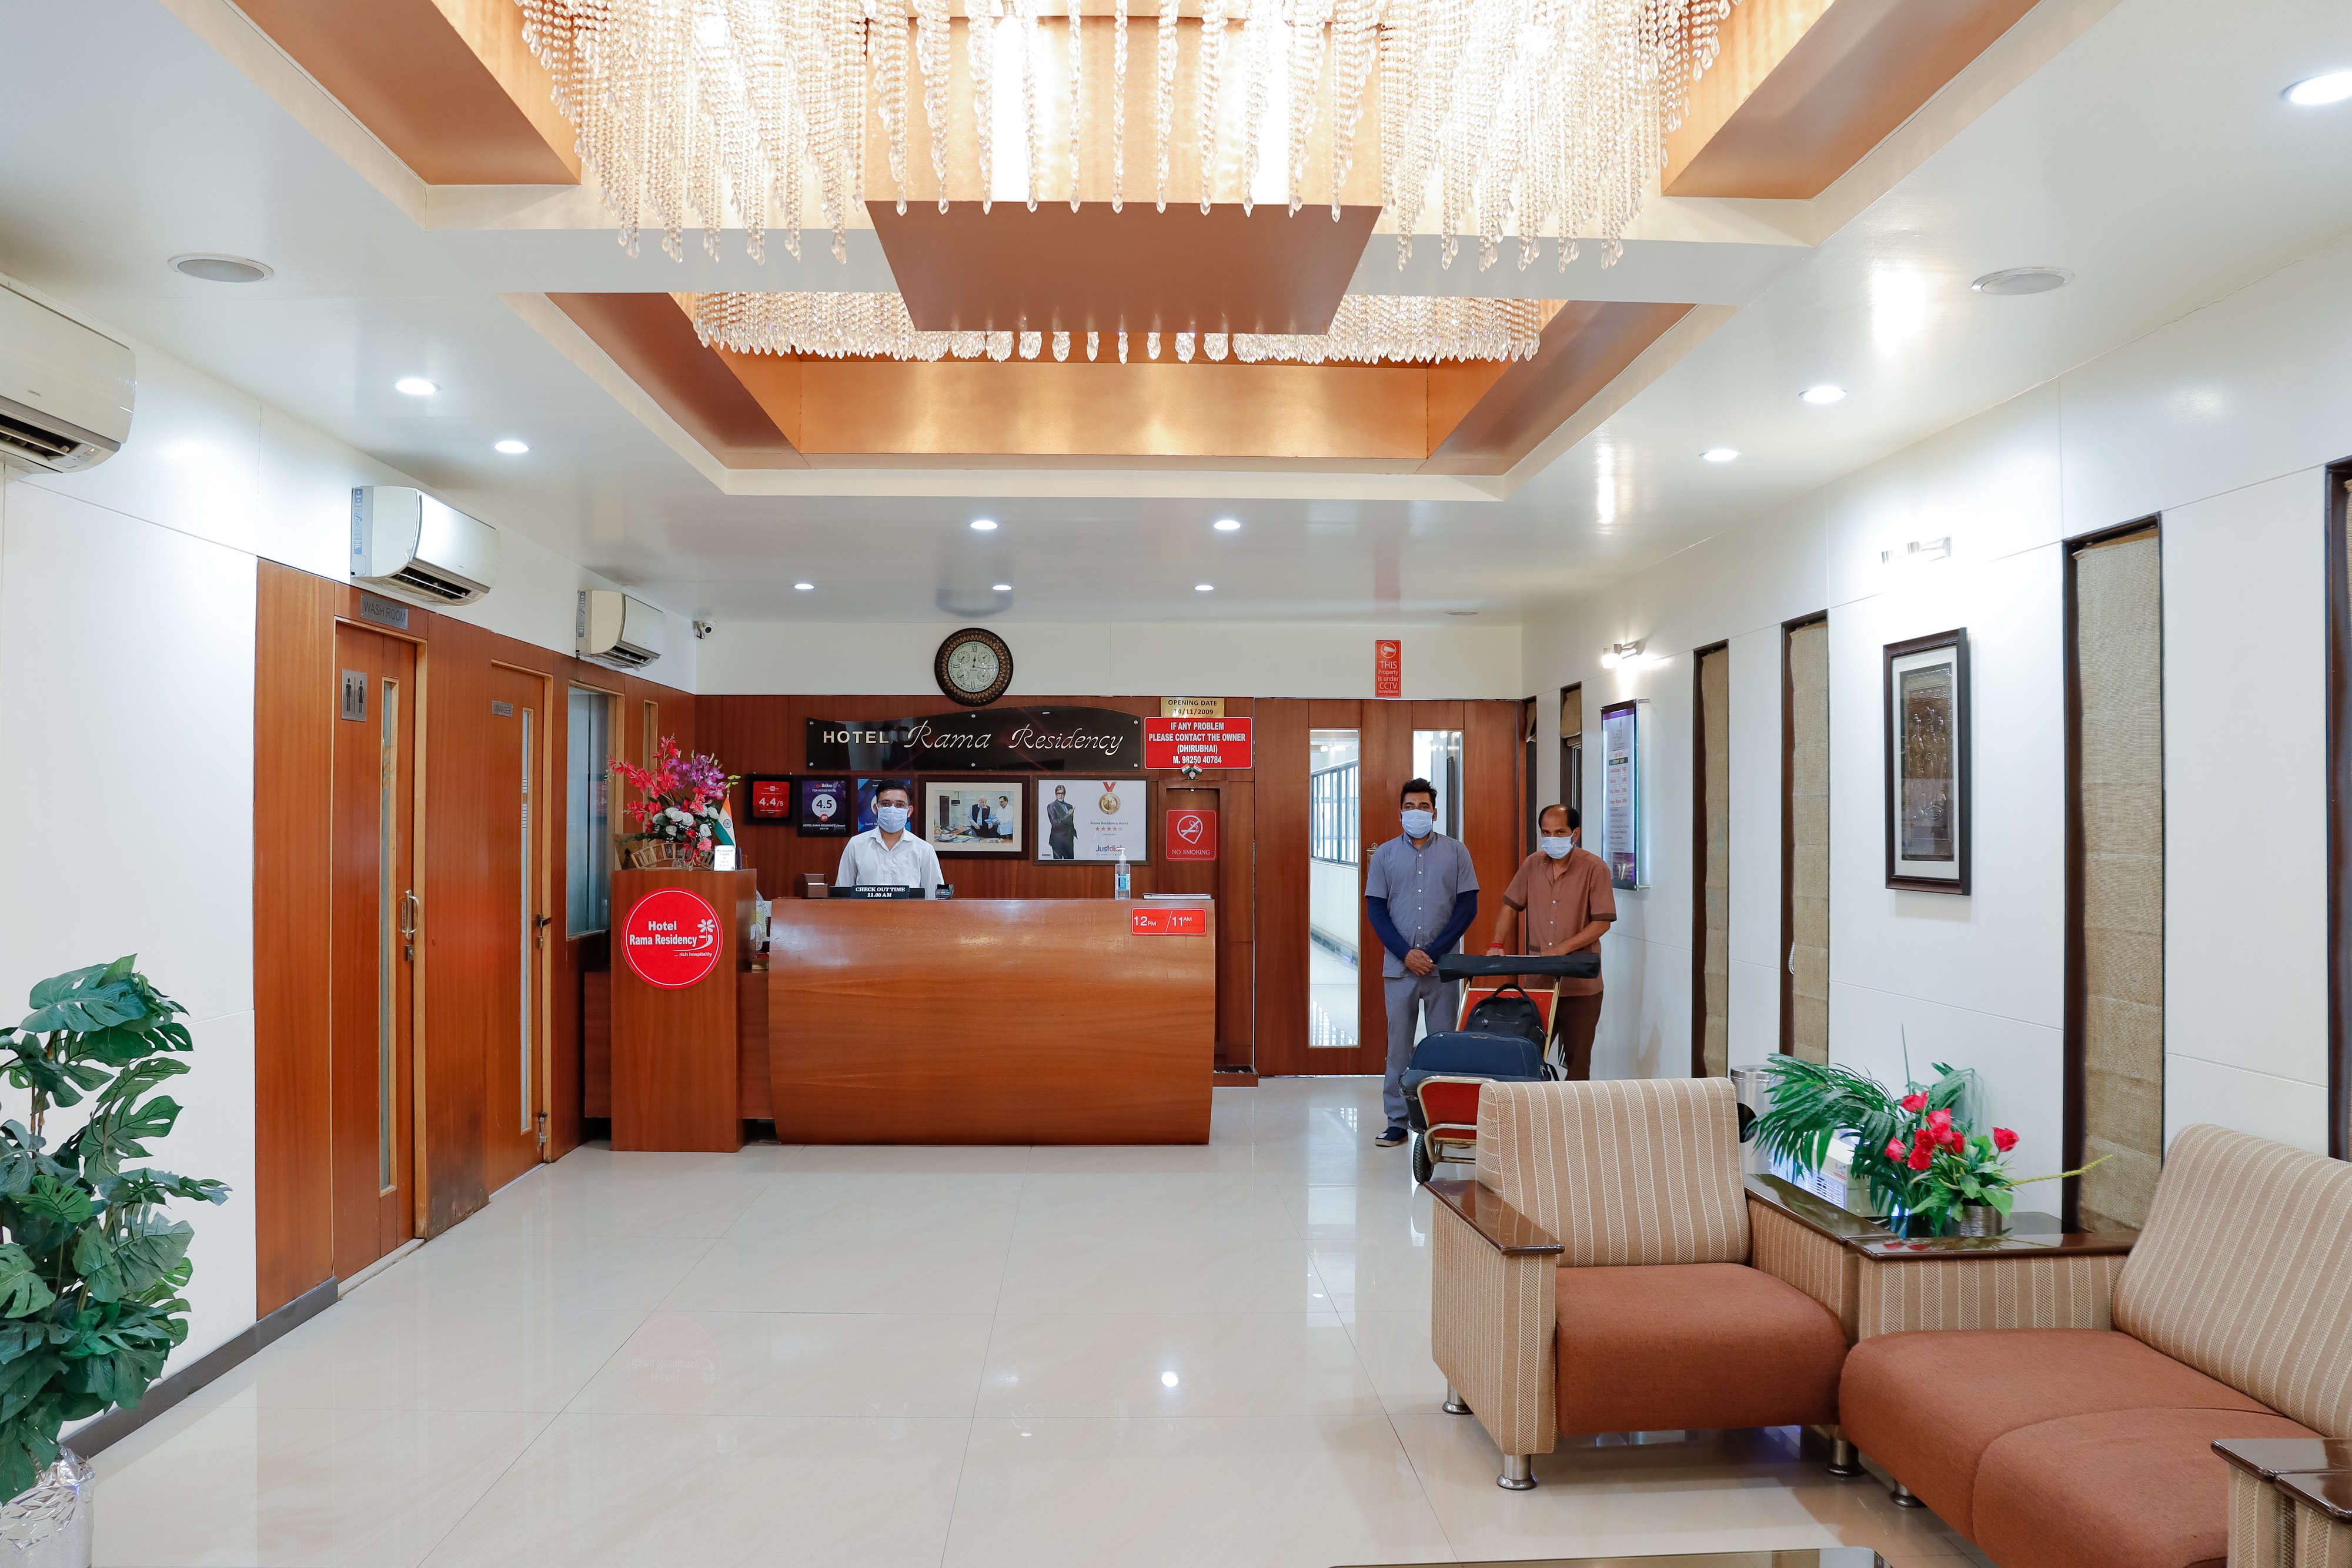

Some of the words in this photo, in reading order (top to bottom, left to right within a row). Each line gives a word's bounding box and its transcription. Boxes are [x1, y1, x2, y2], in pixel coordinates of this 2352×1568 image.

[364, 601, 384, 615] WASH
[386, 607, 406, 623] ROOM
[1379, 661, 1398, 669] THIS
[1171, 722, 1177, 730] IF
[1178, 722, 1192, 730] ANY
[1193, 722, 1224, 730] PROBLEM
[823, 730, 890, 744] HOTEL
[903, 720, 992, 750] Rama
[1008, 724, 1124, 755] Residency
[1148, 733, 1174, 741] PLEASE
[1175, 733, 1205, 741] CONTACT
[1207, 733, 1221, 741] THE
[1222, 733, 1246, 741] OWNER
[1177, 744, 1218, 754] (DHIRUBHAI)
[1172, 755, 1181, 764] M.
[1182, 755, 1201, 764] 98250
[1202, 755, 1222, 764] 40784
[759, 797, 784, 807] 4.4/5
[816, 800, 832, 808] 4.5
[647, 921, 677, 931] Hotel
[629, 934, 653, 945] Rama
[655, 934, 697, 947] Residency
